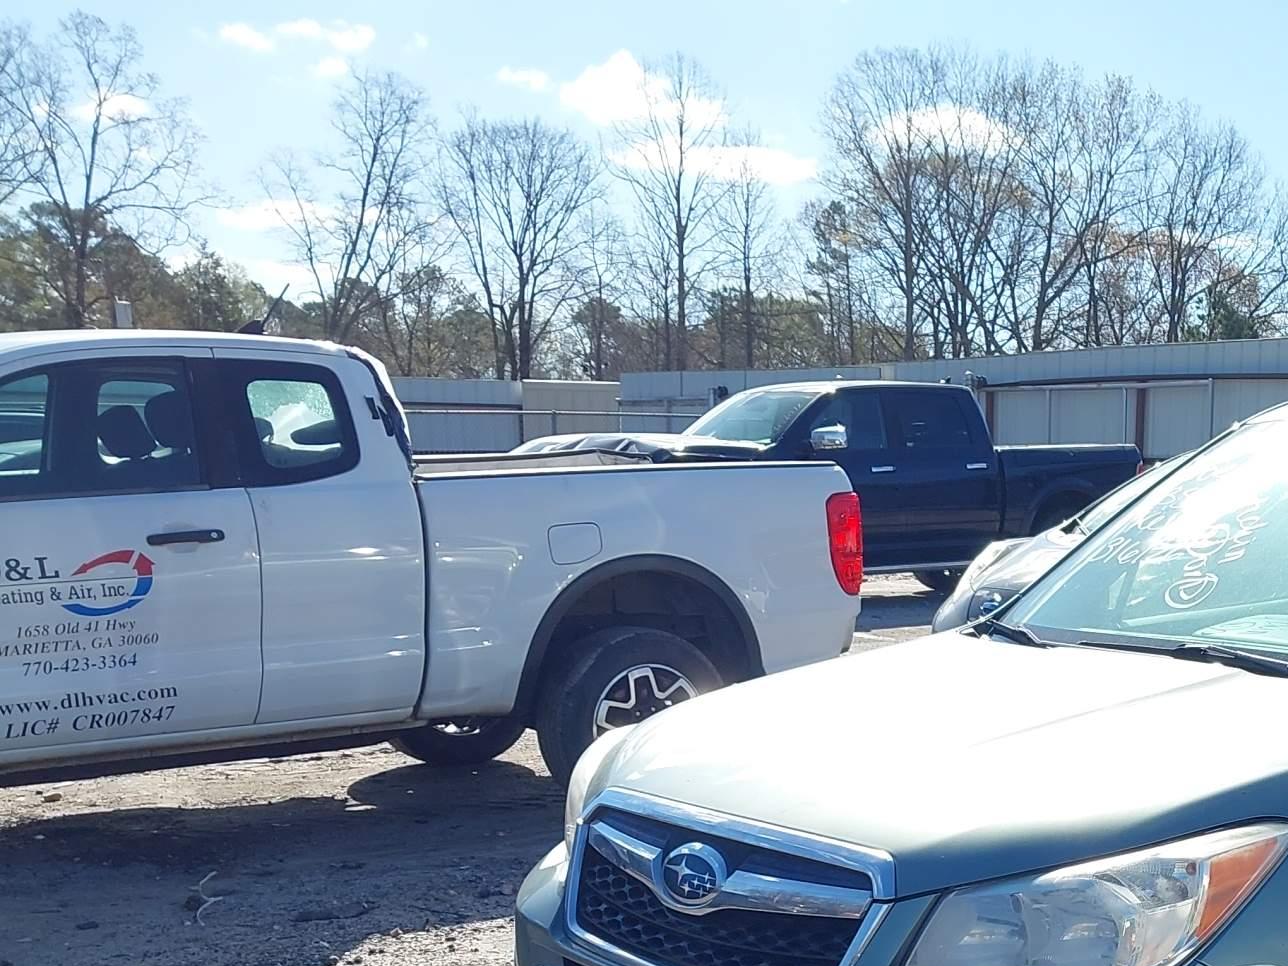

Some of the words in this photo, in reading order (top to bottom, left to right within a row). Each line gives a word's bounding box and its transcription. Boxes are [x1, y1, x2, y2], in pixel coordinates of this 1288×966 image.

[0, 557, 60, 581] &L
[0, 588, 44, 606] ating
[50, 586, 62, 601] &
[68, 584, 97, 601] Air,
[101, 583, 130, 598] Inc.
[17, 624, 49, 639] 1658
[54, 621, 80, 636] Old
[84, 619, 100, 633] 41
[105, 618, 137, 633] Hwy
[91, 636, 113, 650] GA
[118, 631, 160, 647] 30060
[22, 652, 137, 676] 770-423-3364
[0, 686, 178, 716] www.dlhvac.com
[5, 717, 60, 739] LIC#
[72, 705, 176, 732] CR007847
